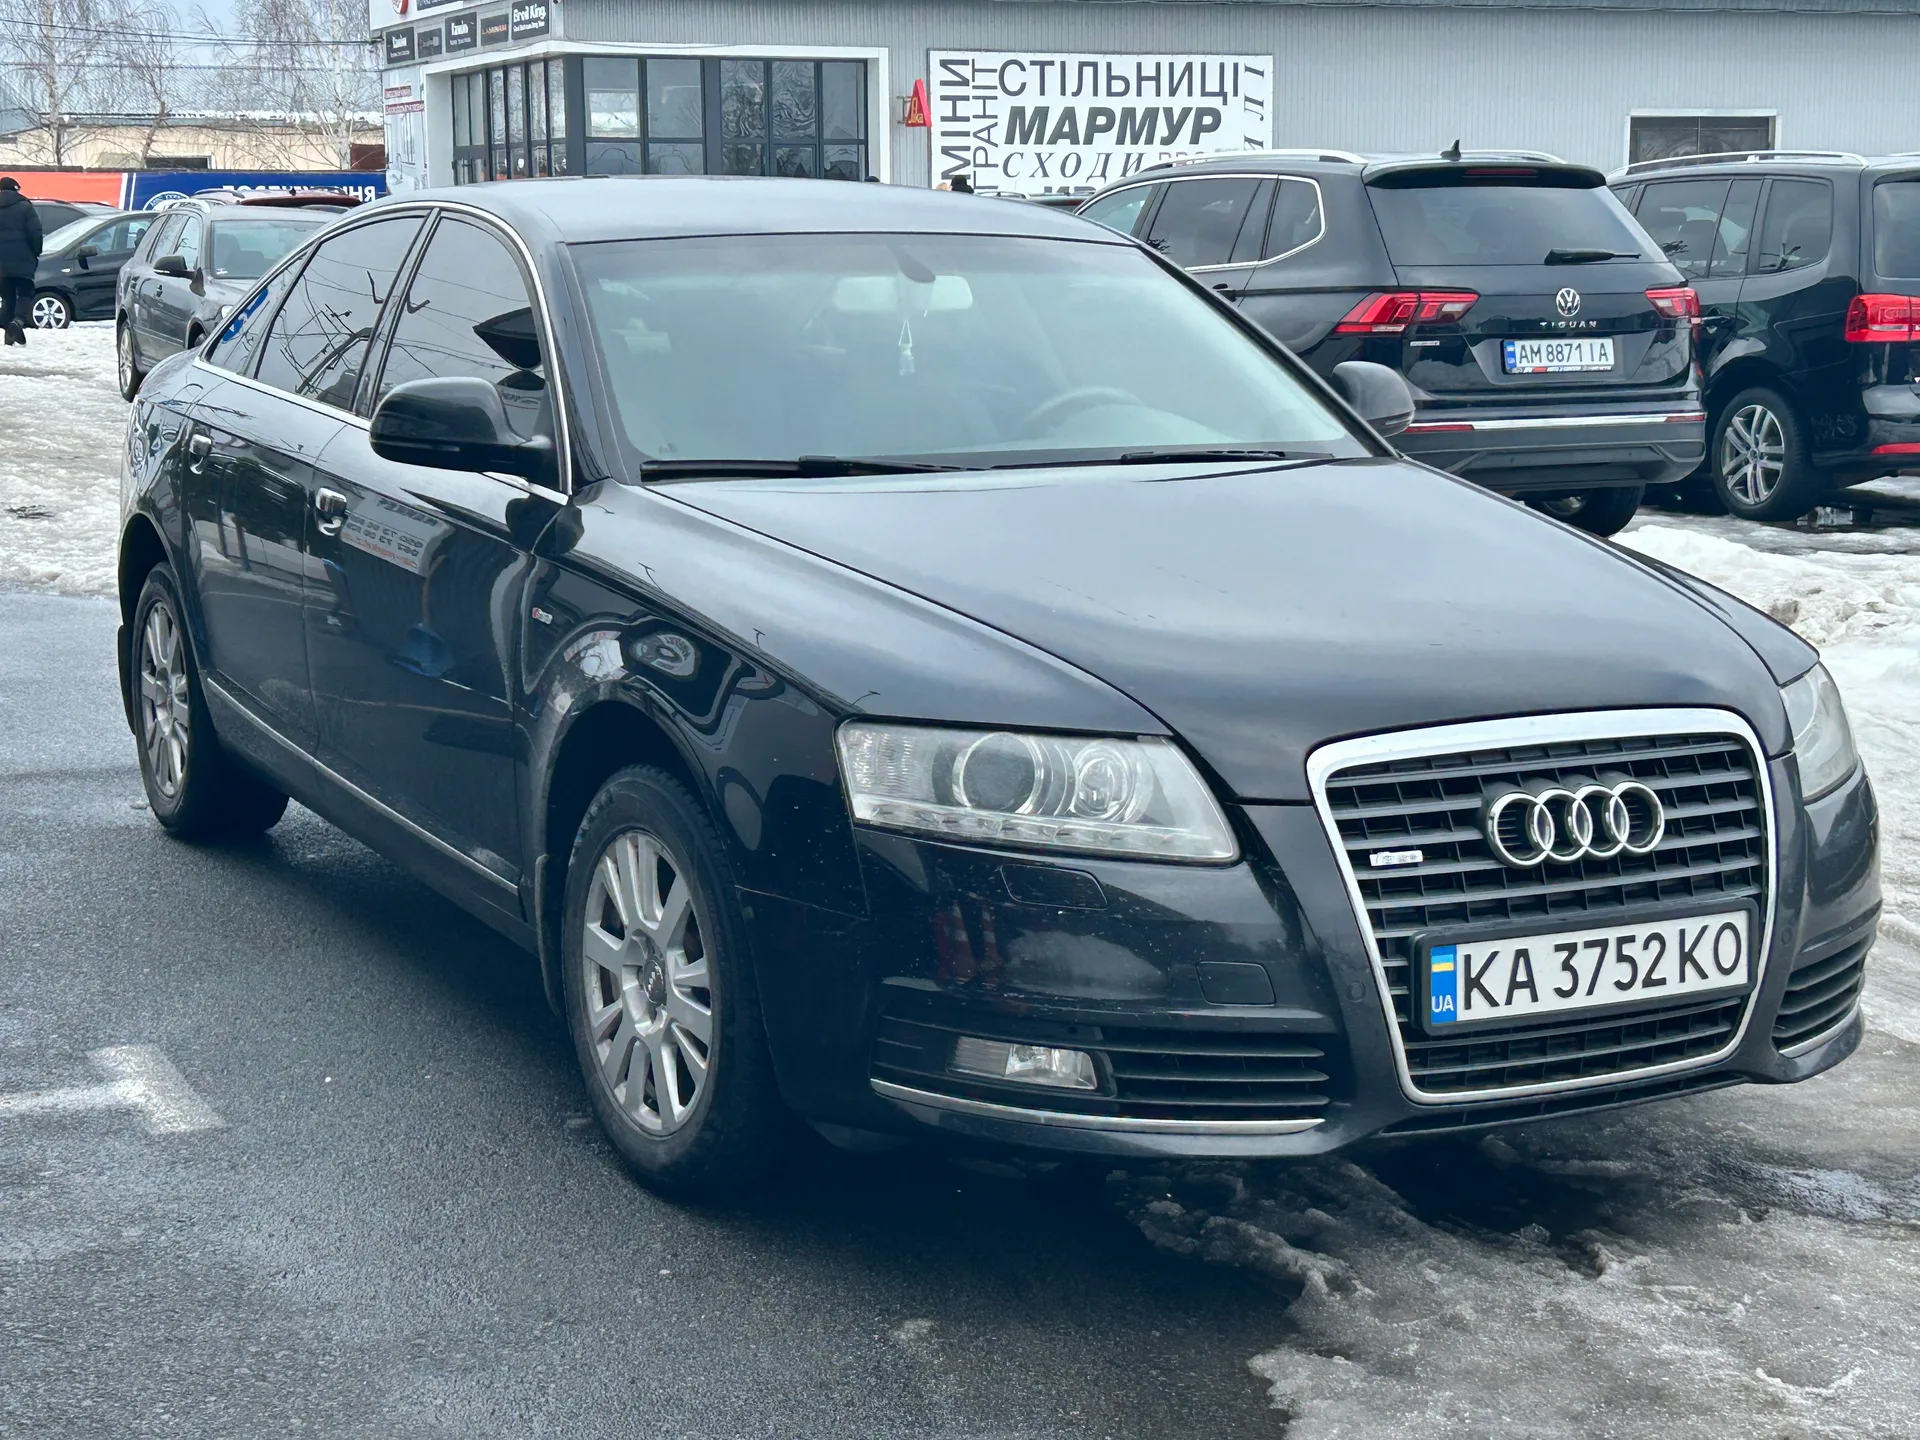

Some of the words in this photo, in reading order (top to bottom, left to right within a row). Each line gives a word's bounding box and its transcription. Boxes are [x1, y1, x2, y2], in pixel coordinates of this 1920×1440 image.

[998, 58, 1240, 106] СТІЛЬНИЦІ
[972, 58, 999, 189] ГРАНІТ
[1004, 105, 1222, 146] МАРМУР
[1002, 152, 1147, 183] СХОДИ
[1540, 320, 1597, 329] TIGUAN
[1431, 994, 1454, 1013] UA
